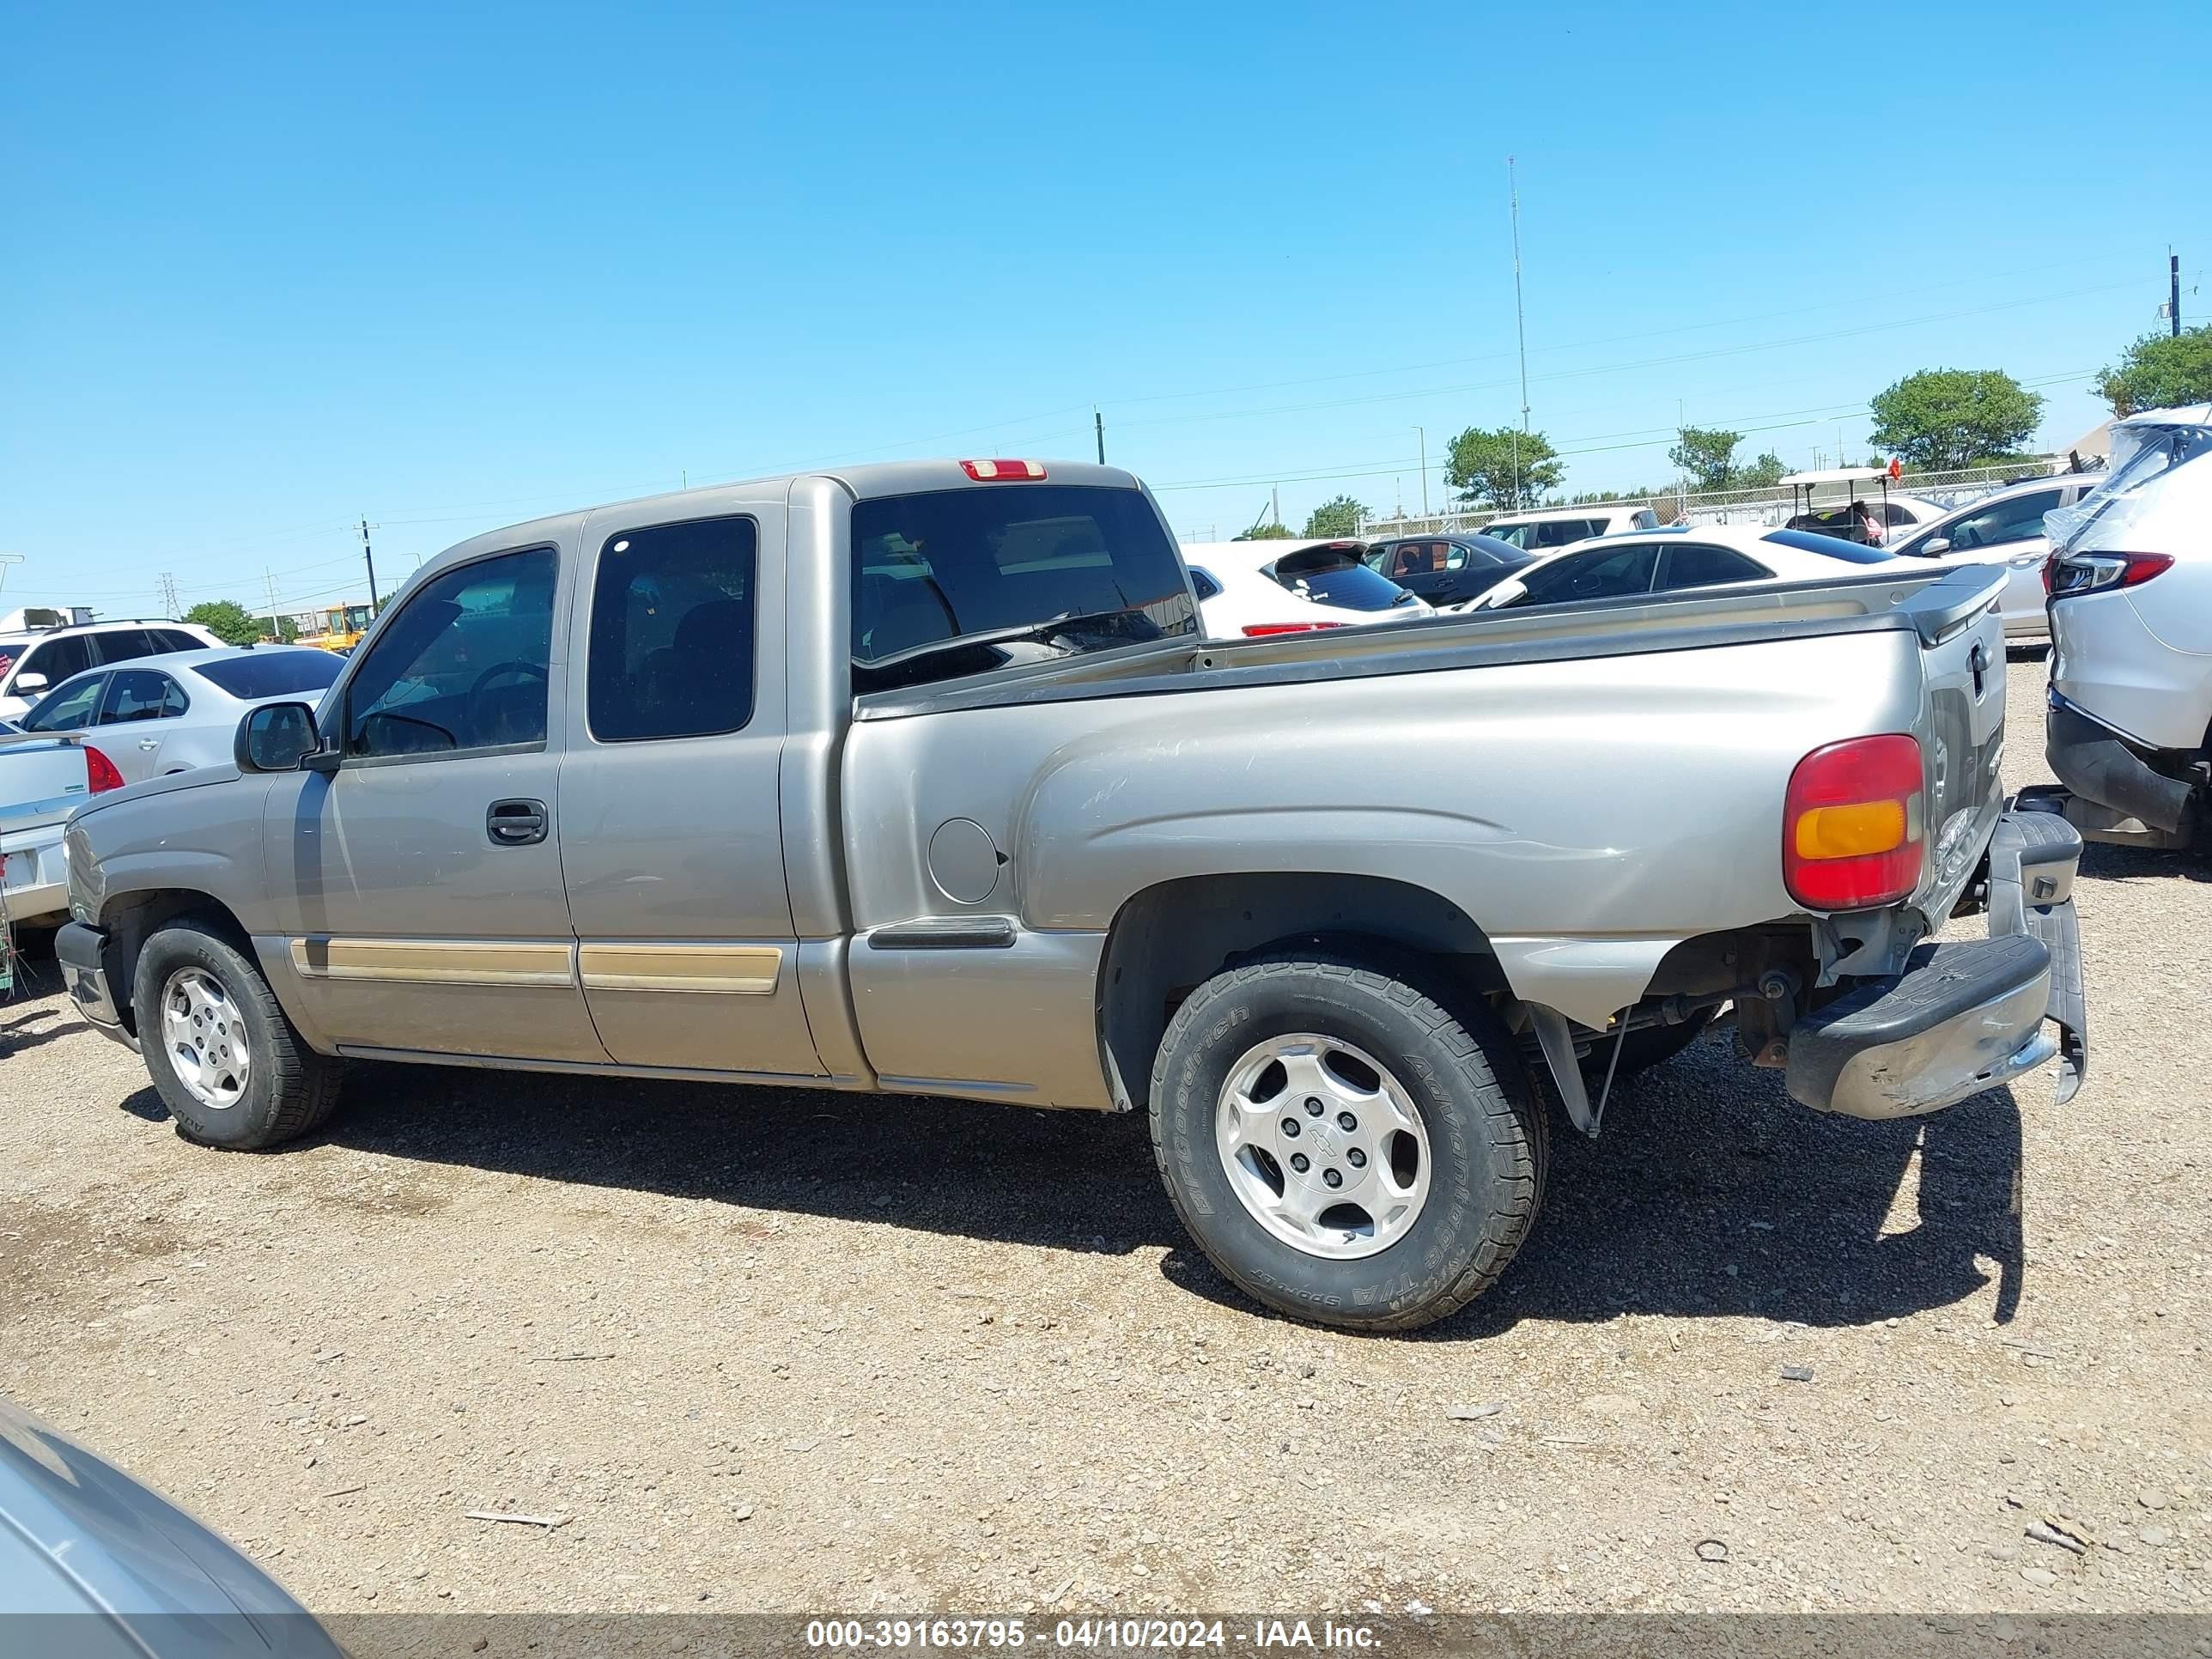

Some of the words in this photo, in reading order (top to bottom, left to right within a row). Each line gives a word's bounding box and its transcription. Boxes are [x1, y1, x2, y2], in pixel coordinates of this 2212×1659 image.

[1174, 1005, 1249, 1216] BFGoodrich
[1401, 1054, 1470, 1272] Advantage
[1352, 1272, 1419, 1307] T/A
